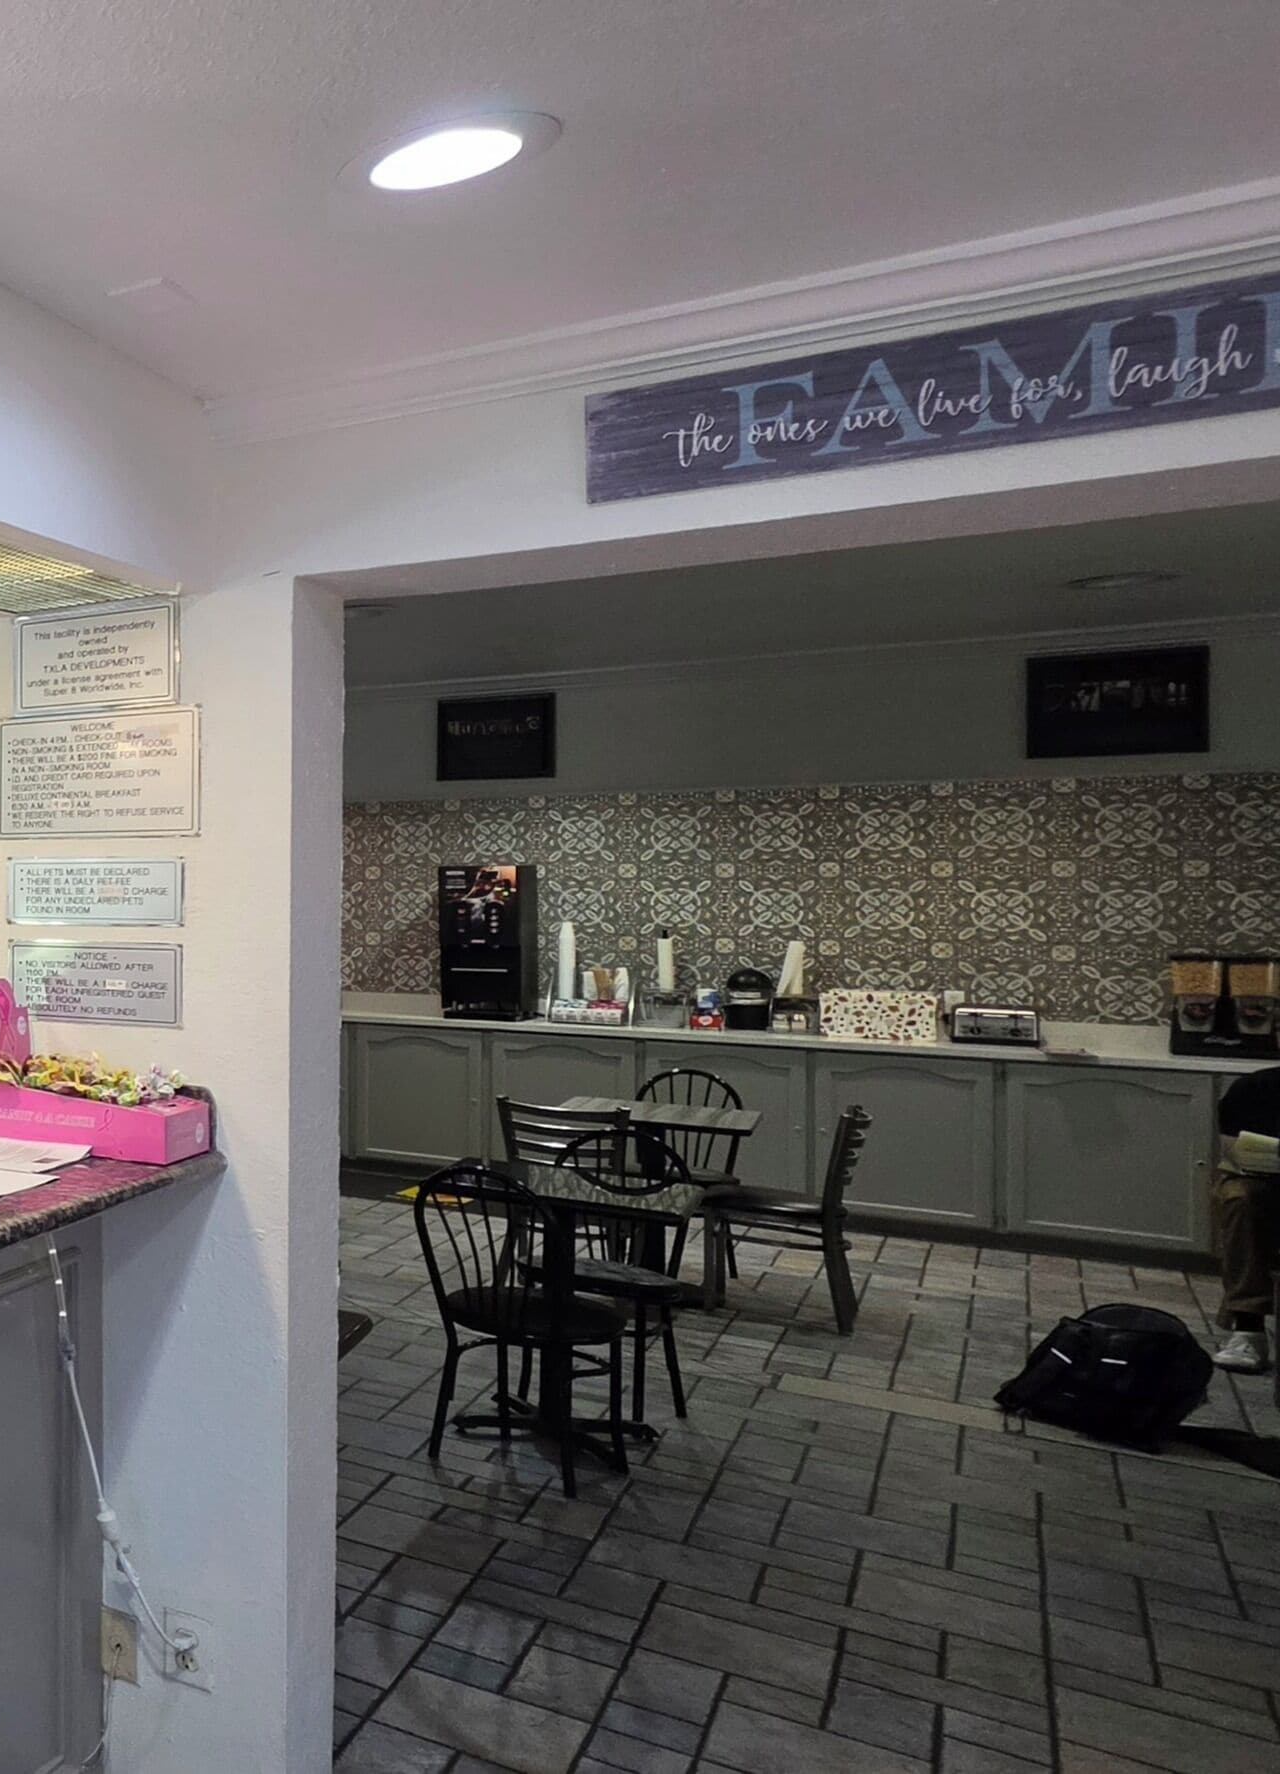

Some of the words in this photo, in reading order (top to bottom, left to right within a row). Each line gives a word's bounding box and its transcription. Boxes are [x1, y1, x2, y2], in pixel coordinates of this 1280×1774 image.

[662, 412, 734, 469] the
[747, 418, 829, 445] ones
[843, 408, 907, 431] we
[917, 377, 992, 428] live
[1008, 374, 1084, 418] for,
[1107, 323, 1253, 398] laugh
[34, 632, 51, 641] This
[54, 629, 80, 639] facility
[93, 620, 155, 634] independently
[78, 636, 108, 646] owned
[57, 651, 74, 660] and
[77, 647, 116, 657] operated
[118, 645, 129, 654] by
[43, 663, 67, 673] TXLA
[70, 656, 145, 671] DEVELOPMENTS
[26, 677, 50, 688] under
[61, 673, 90, 684] license
[94, 670, 141, 682] agreement
[144, 668, 163, 676] with
[43, 686, 68, 697] Super
[129, 681, 144, 689] Inc.
[70, 722, 115, 732] WELCOME
[78, 753, 98, 762] $200
[100, 752, 118, 760] FINE
[119, 751, 137, 759] FOR
[138, 748, 177, 758] SMOKING
[86, 762, 111, 770] ROOM
[24, 774, 40, 782] AND
[41, 773, 69, 782] CREDIT
[72, 772, 93, 780] CARD
[95, 771, 135, 779] REQUIRED
[137, 769, 161, 777] UPON
[12, 783, 64, 792] REGISTRATION
[12, 793, 39, 801] DELUXE
[41, 791, 91, 800] CONTINENTAL
[95, 789, 142, 798] BREAKFAST
[12, 812, 24, 820] WE
[25, 811, 58, 819] RESERVE
[61, 810, 76, 818] THE
[77, 809, 100, 817] RIGHT
[104, 809, 114, 817] TO
[116, 808, 148, 817] REFUSE
[150, 807, 184, 815] SERVICE
[23, 820, 53, 828] ANYONE
[26, 868, 40, 876] ALL
[43, 868, 64, 876] PETS
[103, 868, 150, 876] DECLARED
[132, 888, 168, 896] CHARGE
[26, 906, 53, 914] FOUND
[55, 906, 63, 914] IN
[66, 906, 90, 914] ROOM
[74, 952, 108, 960] NOTICE
[26, 960, 38, 968] NO
[42, 961, 77, 969] VISITORS
[80, 962, 121, 971] ALLOWED
[124, 963, 154, 971] AFTER
[26, 977, 52, 985] THERE
[55, 979, 74, 987] WILL
[92, 980, 99, 988] A
[131, 982, 168, 991] CHARGE
[45, 987, 69, 995] EACH
[71, 988, 134, 998] UNREGISTERED
[36, 995, 52, 1003] THE
[80, 1006, 94, 1014] NO
[96, 1007, 137, 1016] REFUNDS
